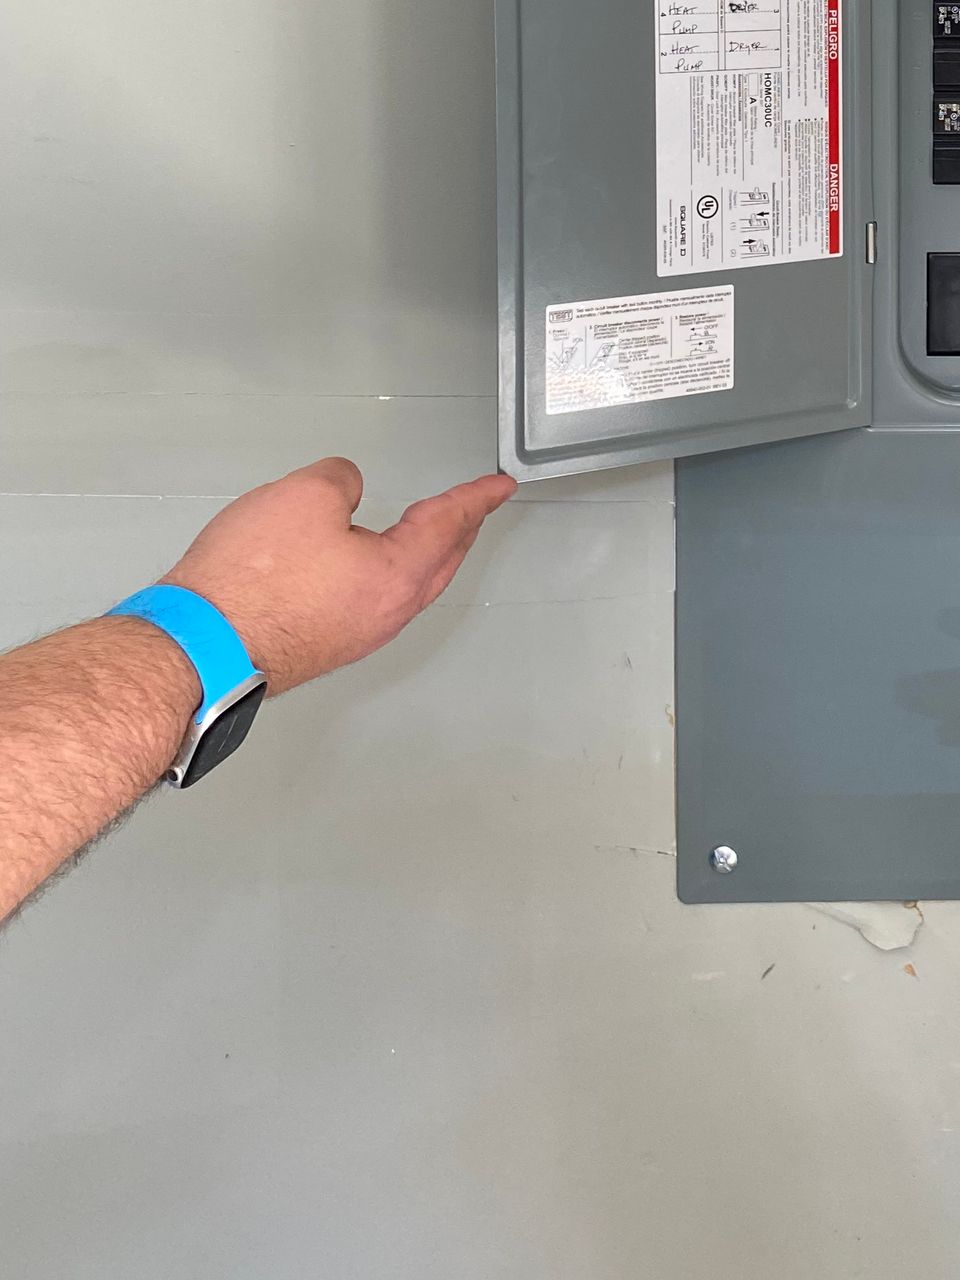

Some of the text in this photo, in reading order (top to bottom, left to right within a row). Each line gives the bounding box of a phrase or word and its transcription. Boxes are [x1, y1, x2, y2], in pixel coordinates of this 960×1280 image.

[669, 2, 699, 16] HEAT
[728, 0, 759, 13] DRYER
[672, 20, 698, 34] PUMP
[829, 9, 838, 60] PELIGRO
[671, 41, 700, 55] HEAT
[729, 41, 767, 56] DRYER
[674, 58, 703, 71] PUMP
[749, 97, 757, 105] A
[764, 72, 773, 128] HOMC30UC
[829, 163, 839, 212] DANGER
[704, 200, 714, 214] UL
[680, 248, 686, 257] D
